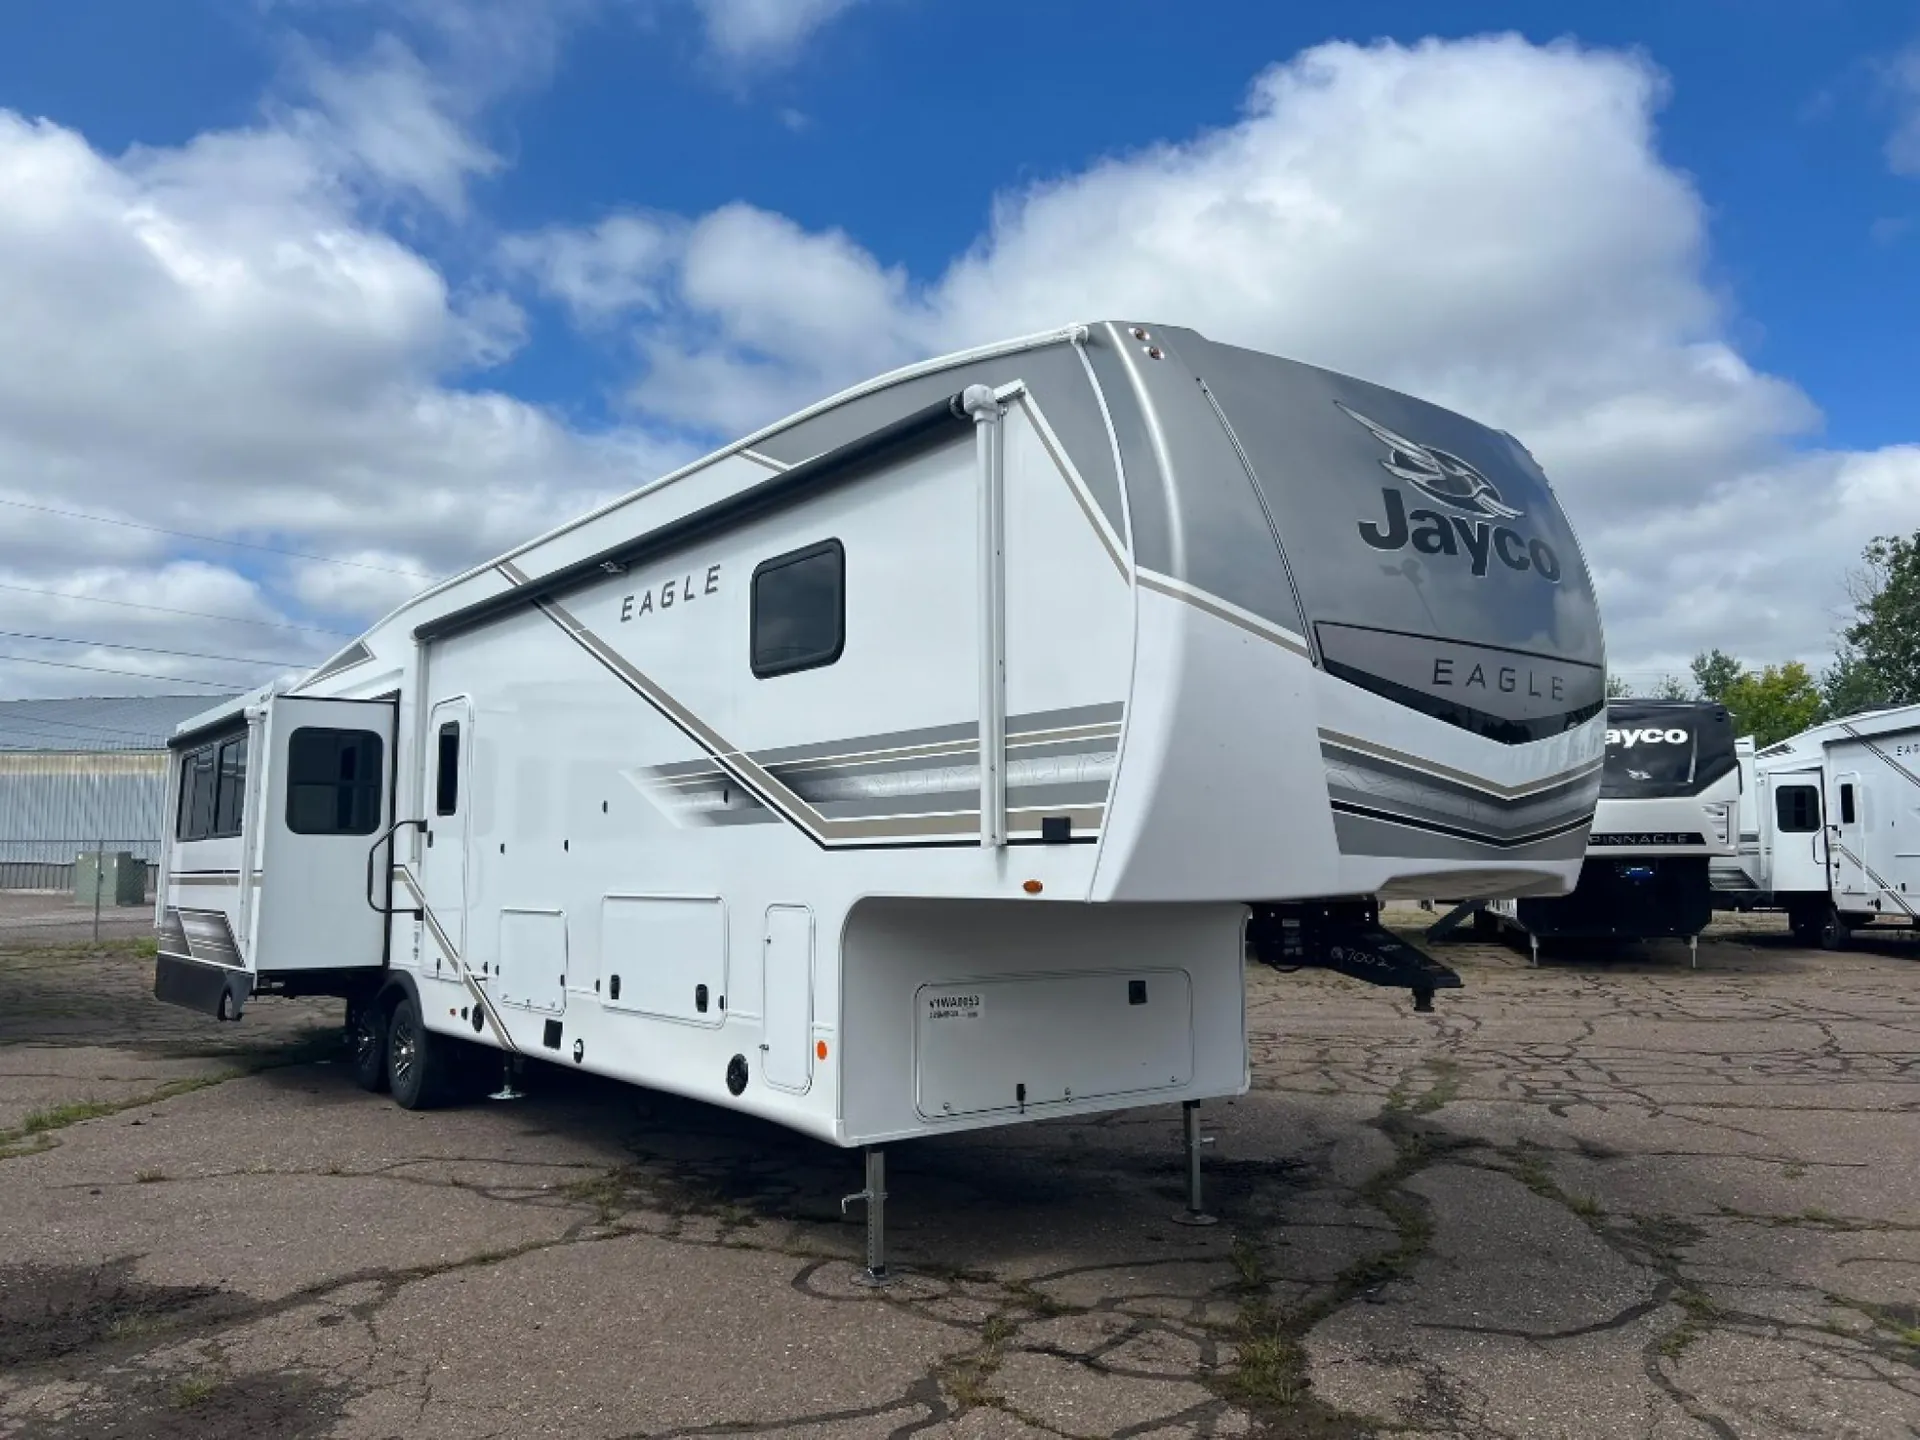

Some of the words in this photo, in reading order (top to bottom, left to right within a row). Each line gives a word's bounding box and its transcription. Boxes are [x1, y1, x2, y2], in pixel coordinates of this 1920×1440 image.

[1357, 487, 1562, 583] Jayco
[620, 563, 721, 623] EAGLE
[1432, 658, 1564, 702] EAGLE
[1605, 729, 1689, 749] ayco
[1896, 743, 1920, 756] EAG
[1590, 834, 1688, 845] PINNACLE
